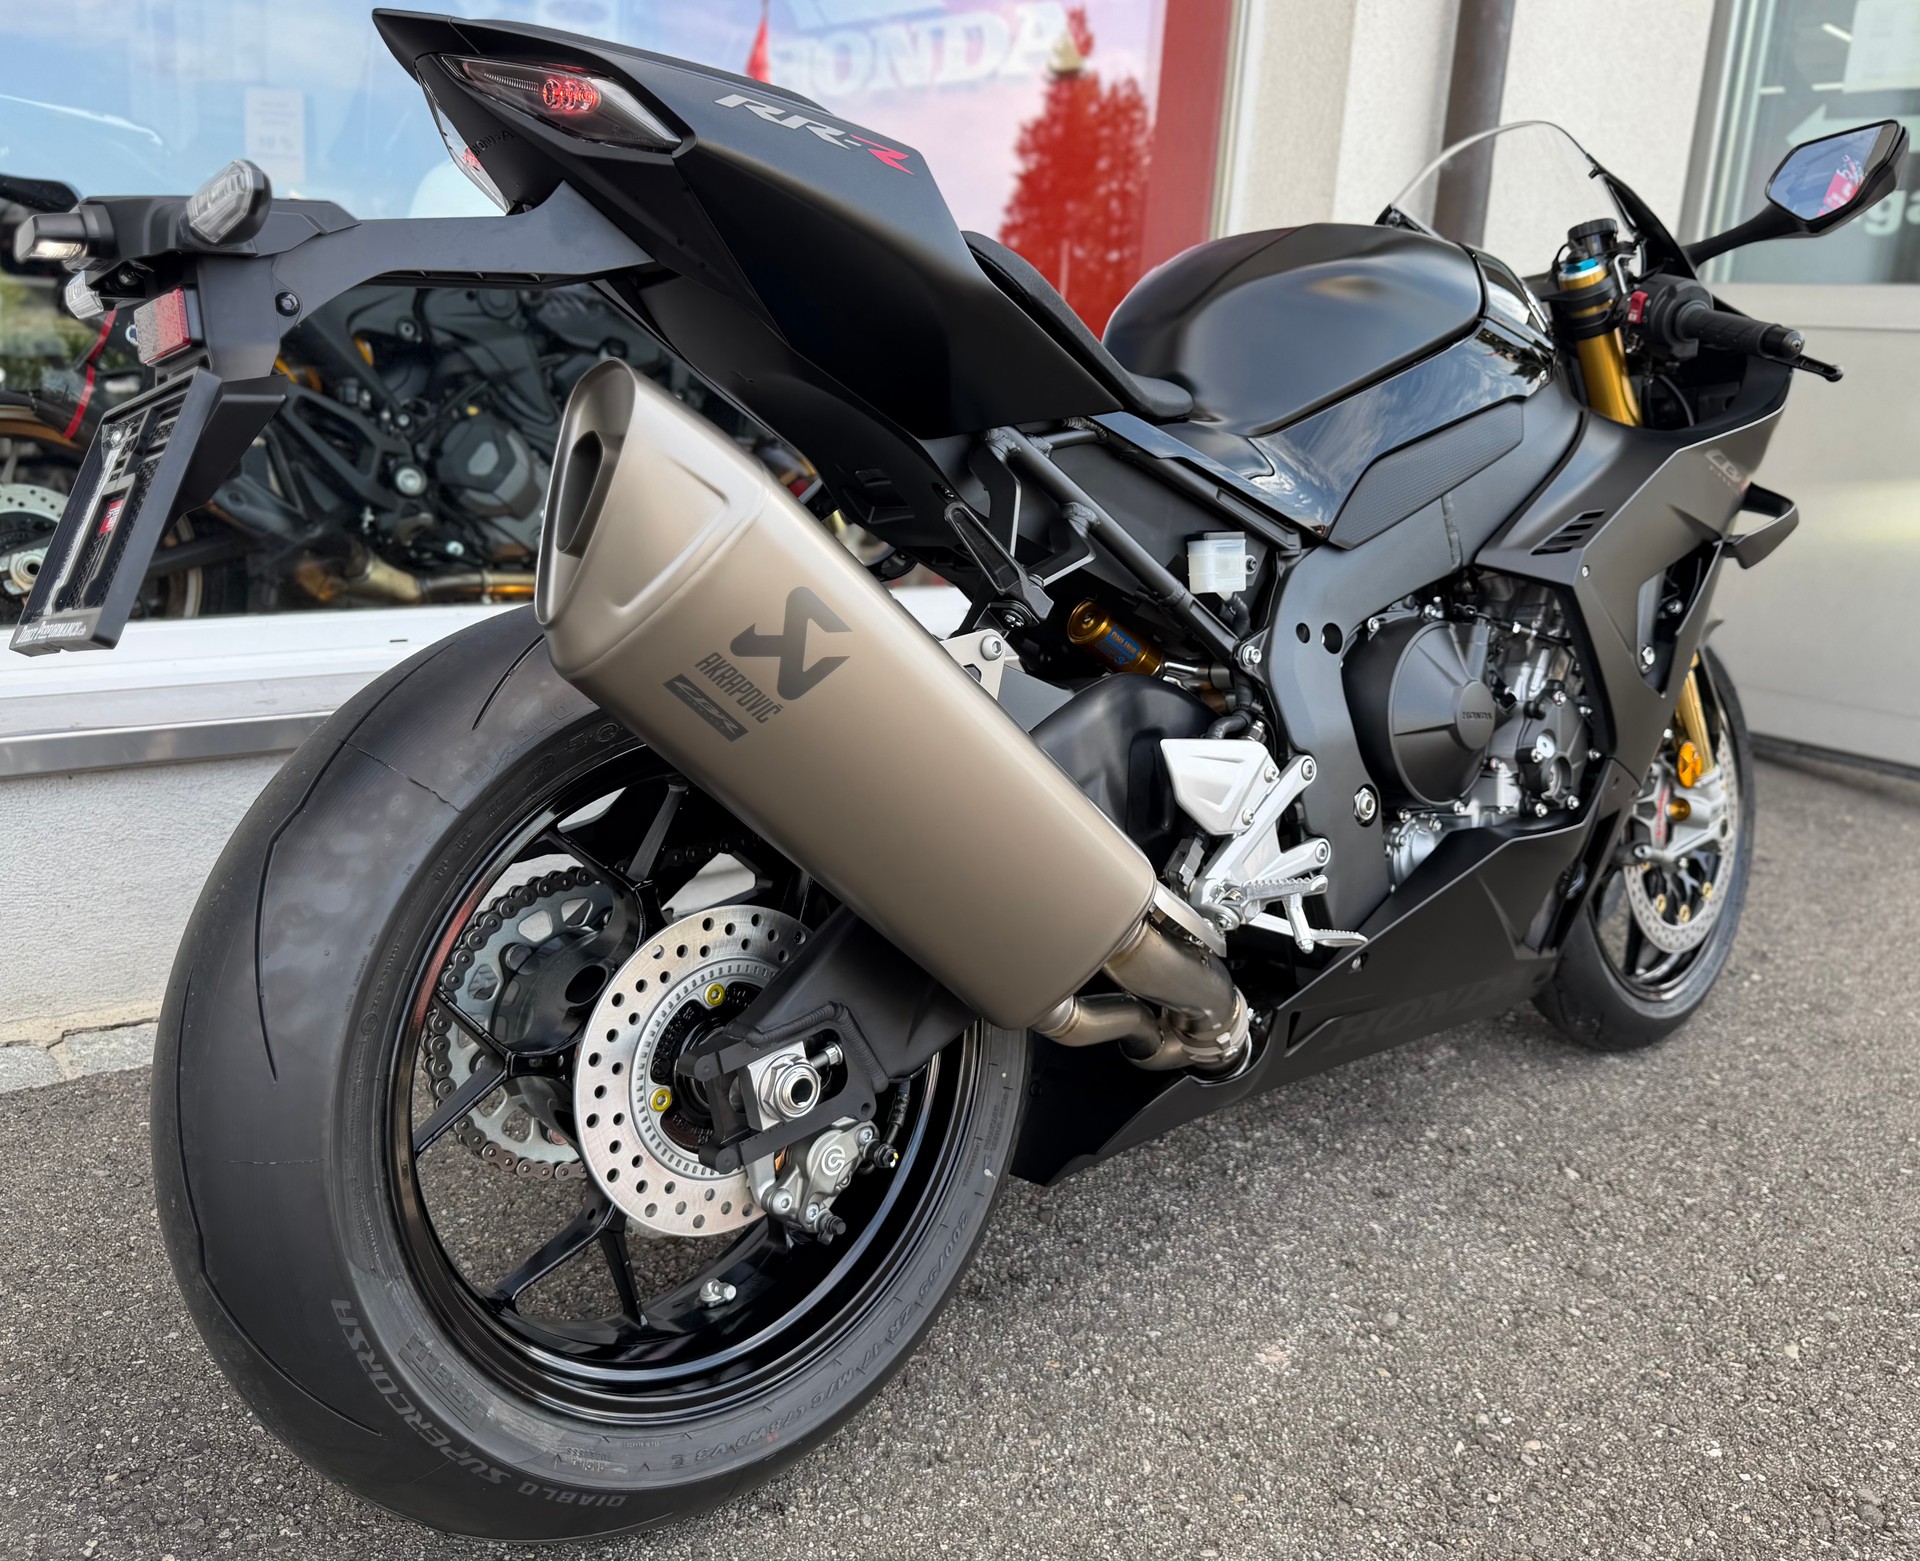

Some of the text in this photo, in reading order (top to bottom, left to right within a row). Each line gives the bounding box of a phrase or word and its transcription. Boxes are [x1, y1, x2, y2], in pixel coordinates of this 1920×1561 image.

[694, 651, 784, 724] AKRAPOVIČ
[1462, 711, 1492, 720] HONDA
[331, 1299, 629, 1507] DIABLO SUPERCORSA
